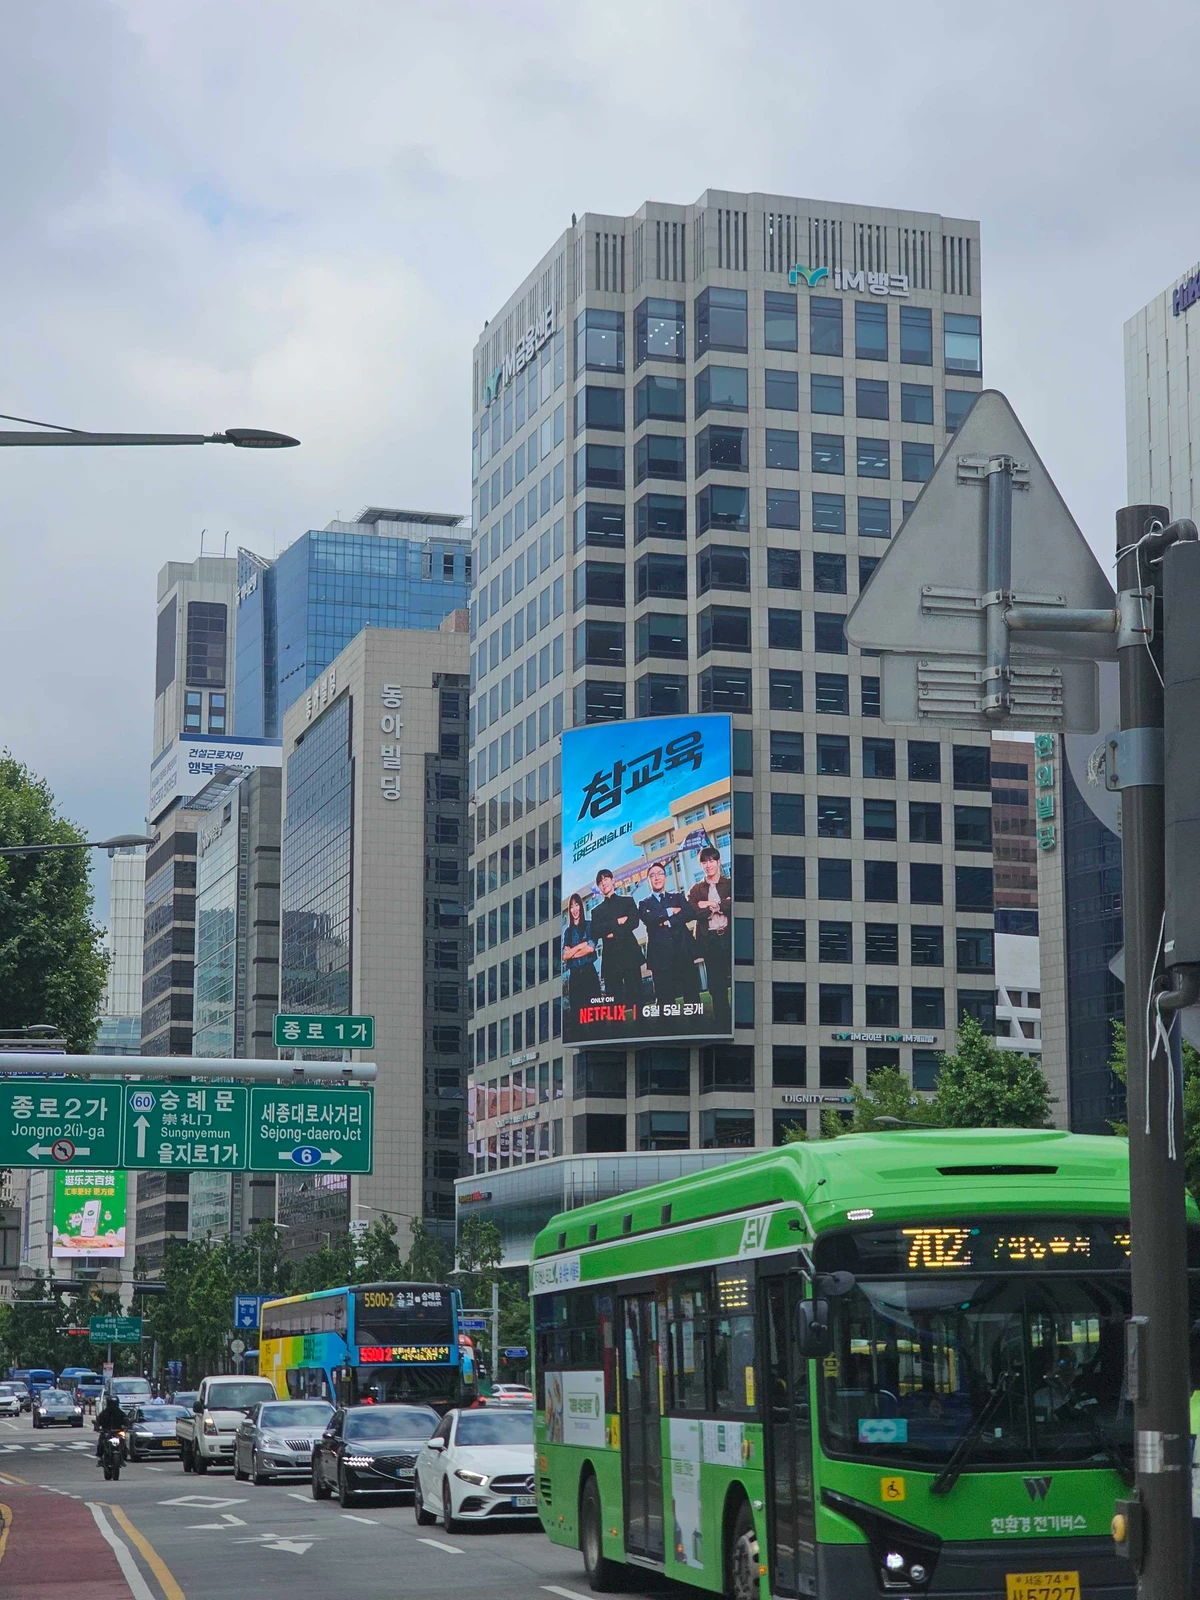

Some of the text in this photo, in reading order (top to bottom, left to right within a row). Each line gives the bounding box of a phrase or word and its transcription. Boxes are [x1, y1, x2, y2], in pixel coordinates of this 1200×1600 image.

[834, 267, 910, 298] iM뱅크
[380, 683, 404, 801] 동아빌딩
[188, 748, 244, 761] 건설근로자의
[576, 730, 705, 822] 참교육
[579, 1004, 626, 1024] NETFLIX
[642, 1003, 704, 1018] 6월 5일 공개
[135, 1096, 151, 1108] 60
[159, 1089, 235, 1112] 숭례문
[784, 1094, 824, 1103] DIGNITY
[10, 1095, 109, 1121] 종로2가
[260, 1102, 362, 1126] 세종대로사거리
[162, 1113, 213, 1126] 崇礼门
[11, 1122, 106, 1140] Jongno 2(i)-ga
[160, 1127, 231, 1141] Sungnyemun
[260, 1124, 362, 1143] Sejong-daero Jct
[157, 1142, 239, 1165] 을지로1가
[301, 1149, 313, 1163] 6
[64, 1174, 115, 1186] 逛乐天百货
[743, 1216, 767, 1252] EV
[364, 1291, 395, 1308] 5500-2
[991, 1515, 1087, 1534] 친환경 전기버스
[1045, 1575, 1061, 1584] 74
